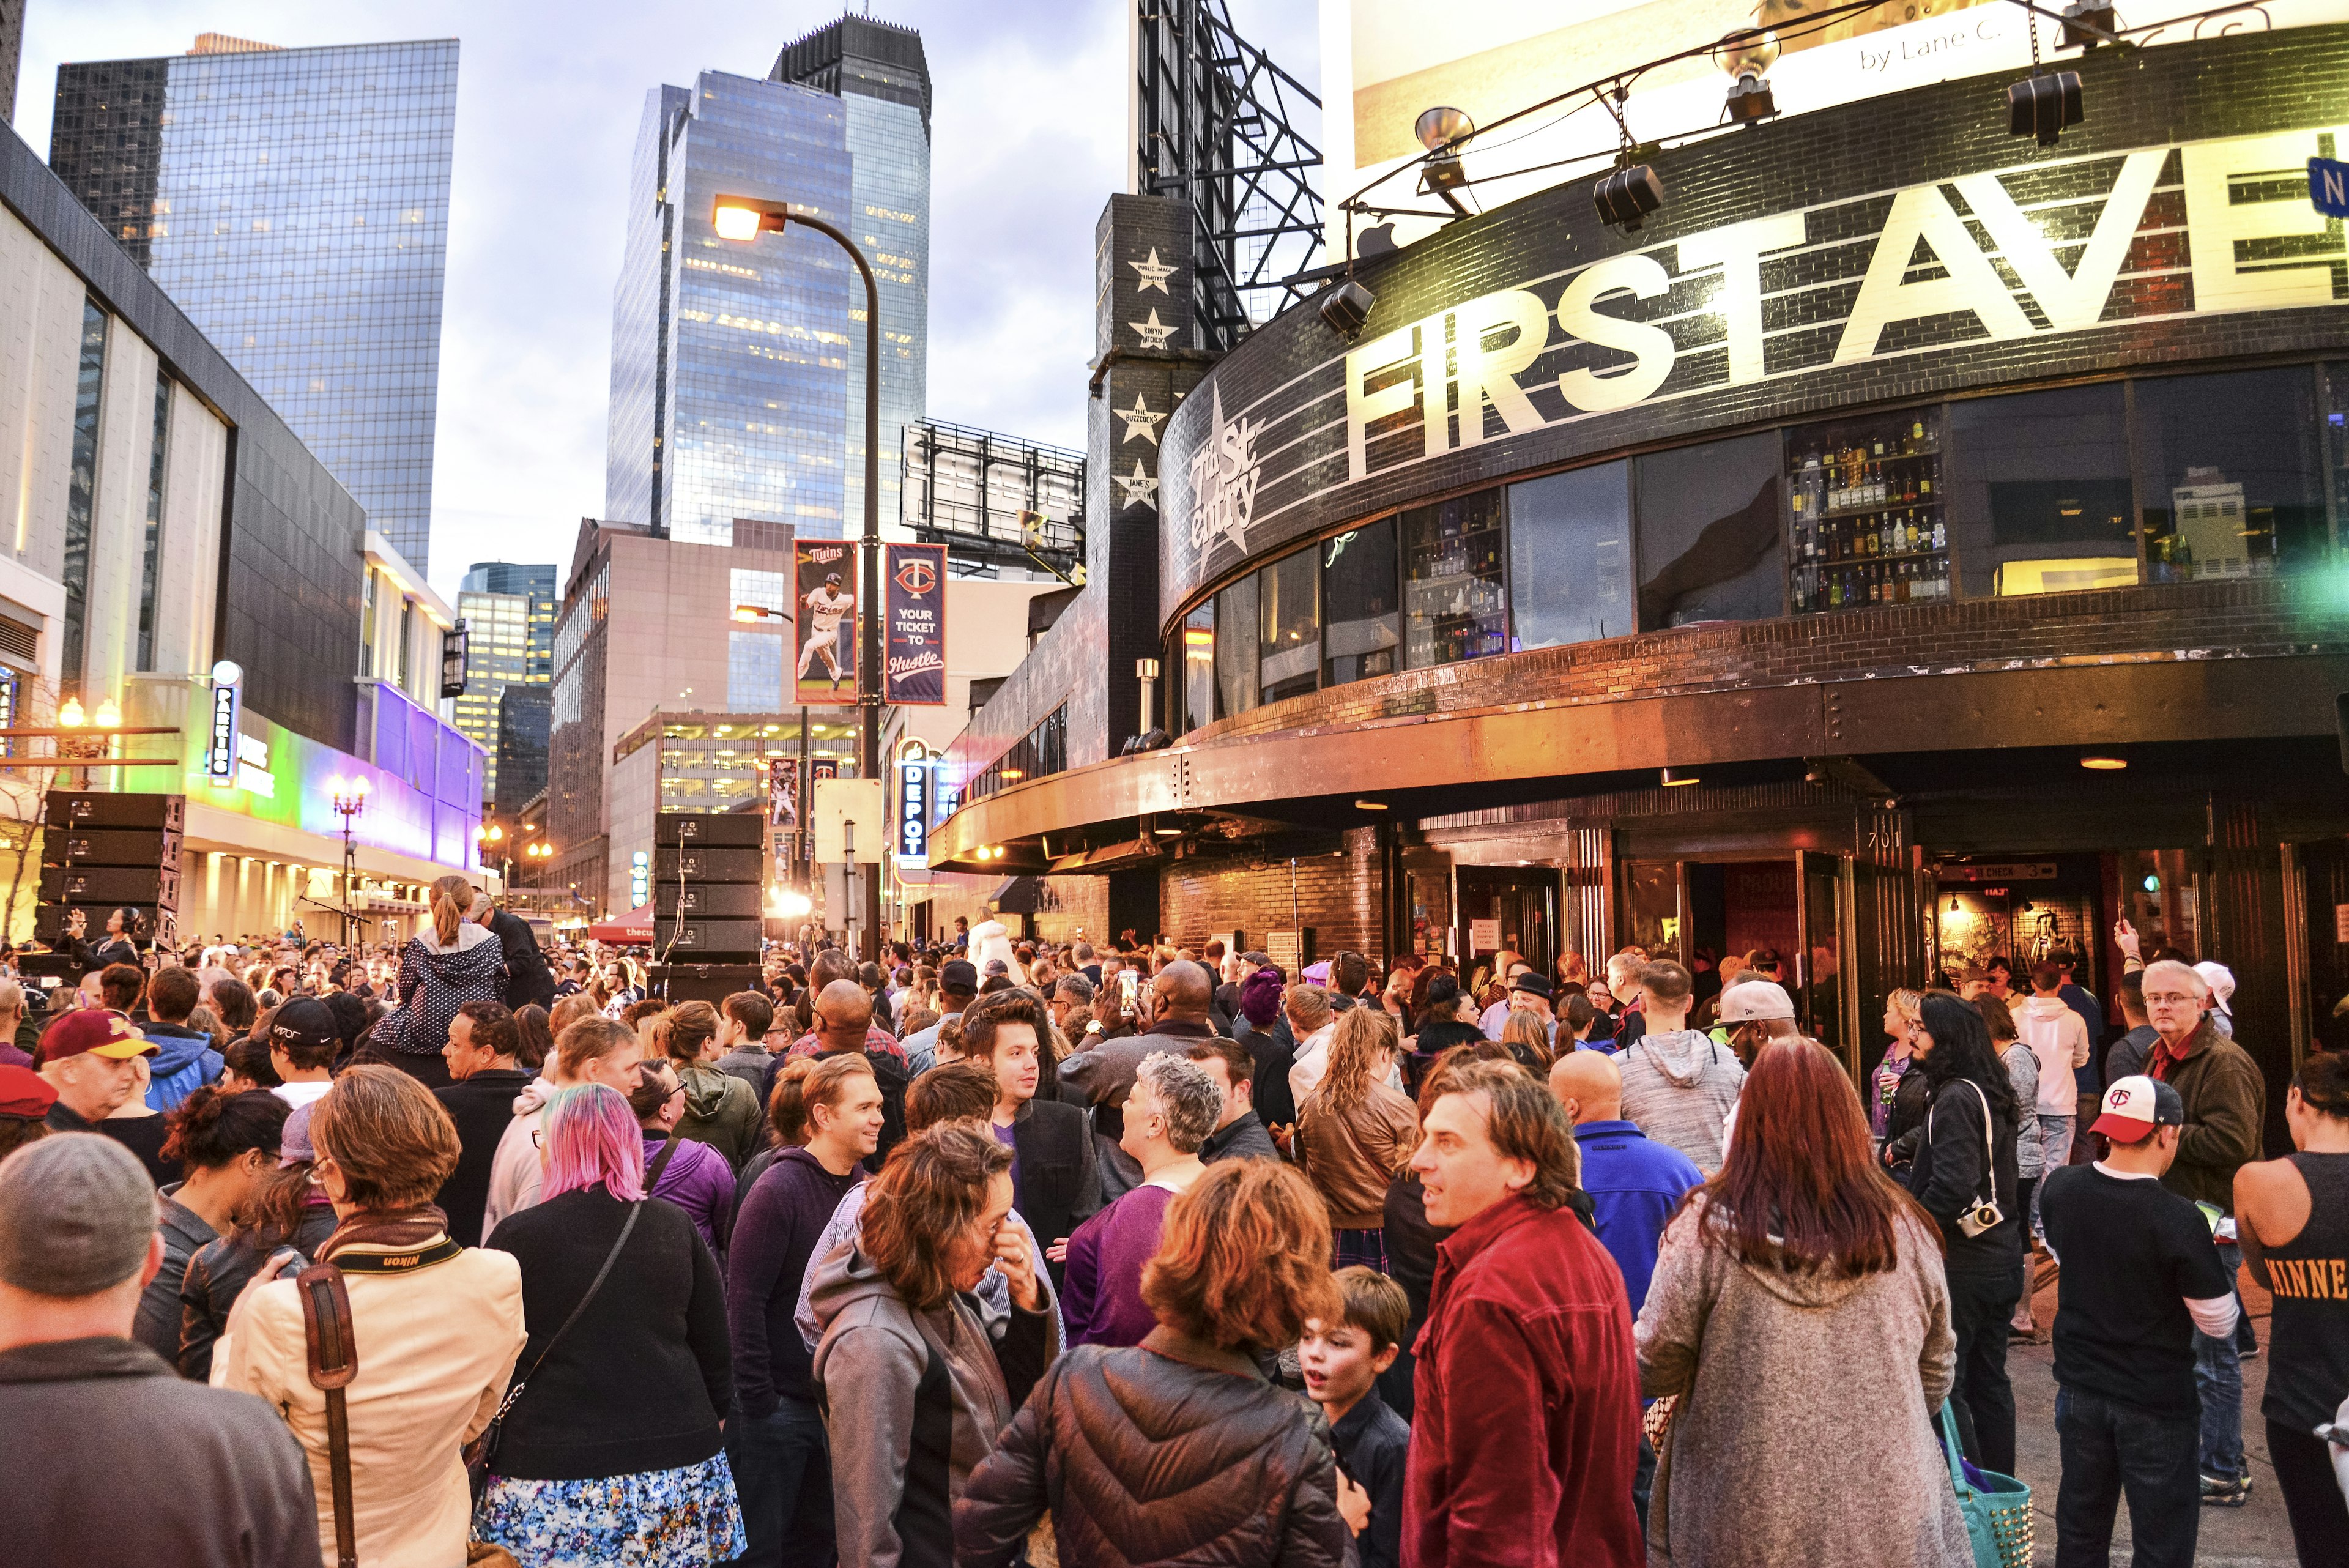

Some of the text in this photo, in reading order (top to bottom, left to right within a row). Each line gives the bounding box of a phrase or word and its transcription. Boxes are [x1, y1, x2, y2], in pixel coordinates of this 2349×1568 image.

[1861, 19, 2001, 72] by Lane C.
[2323, 168, 2345, 206] N
[1346, 126, 2349, 481] FIRST AVE
[1144, 326, 1162, 336] ROBYN
[1126, 414, 1157, 424] BUZZCOCKS
[1189, 417, 1257, 509] 7th St
[1128, 478, 1150, 489] JANE'S
[1127, 490, 1152, 499] ADDICTION
[1192, 466, 1261, 549] entry
[809, 546, 843, 564] Twins
[899, 609, 933, 620] YOUR
[895, 622, 936, 633] TICKET
[908, 636, 924, 645] TO
[887, 651, 944, 675] Hustle
[213, 689, 232, 773] PARKING
[904, 766, 923, 855] DEPOT
[1868, 831, 1899, 848] 701
[1986, 866, 2014, 877] CHECK
[383, 1255, 420, 1267] Nikon
[2264, 1258, 2348, 1300] MINNE
